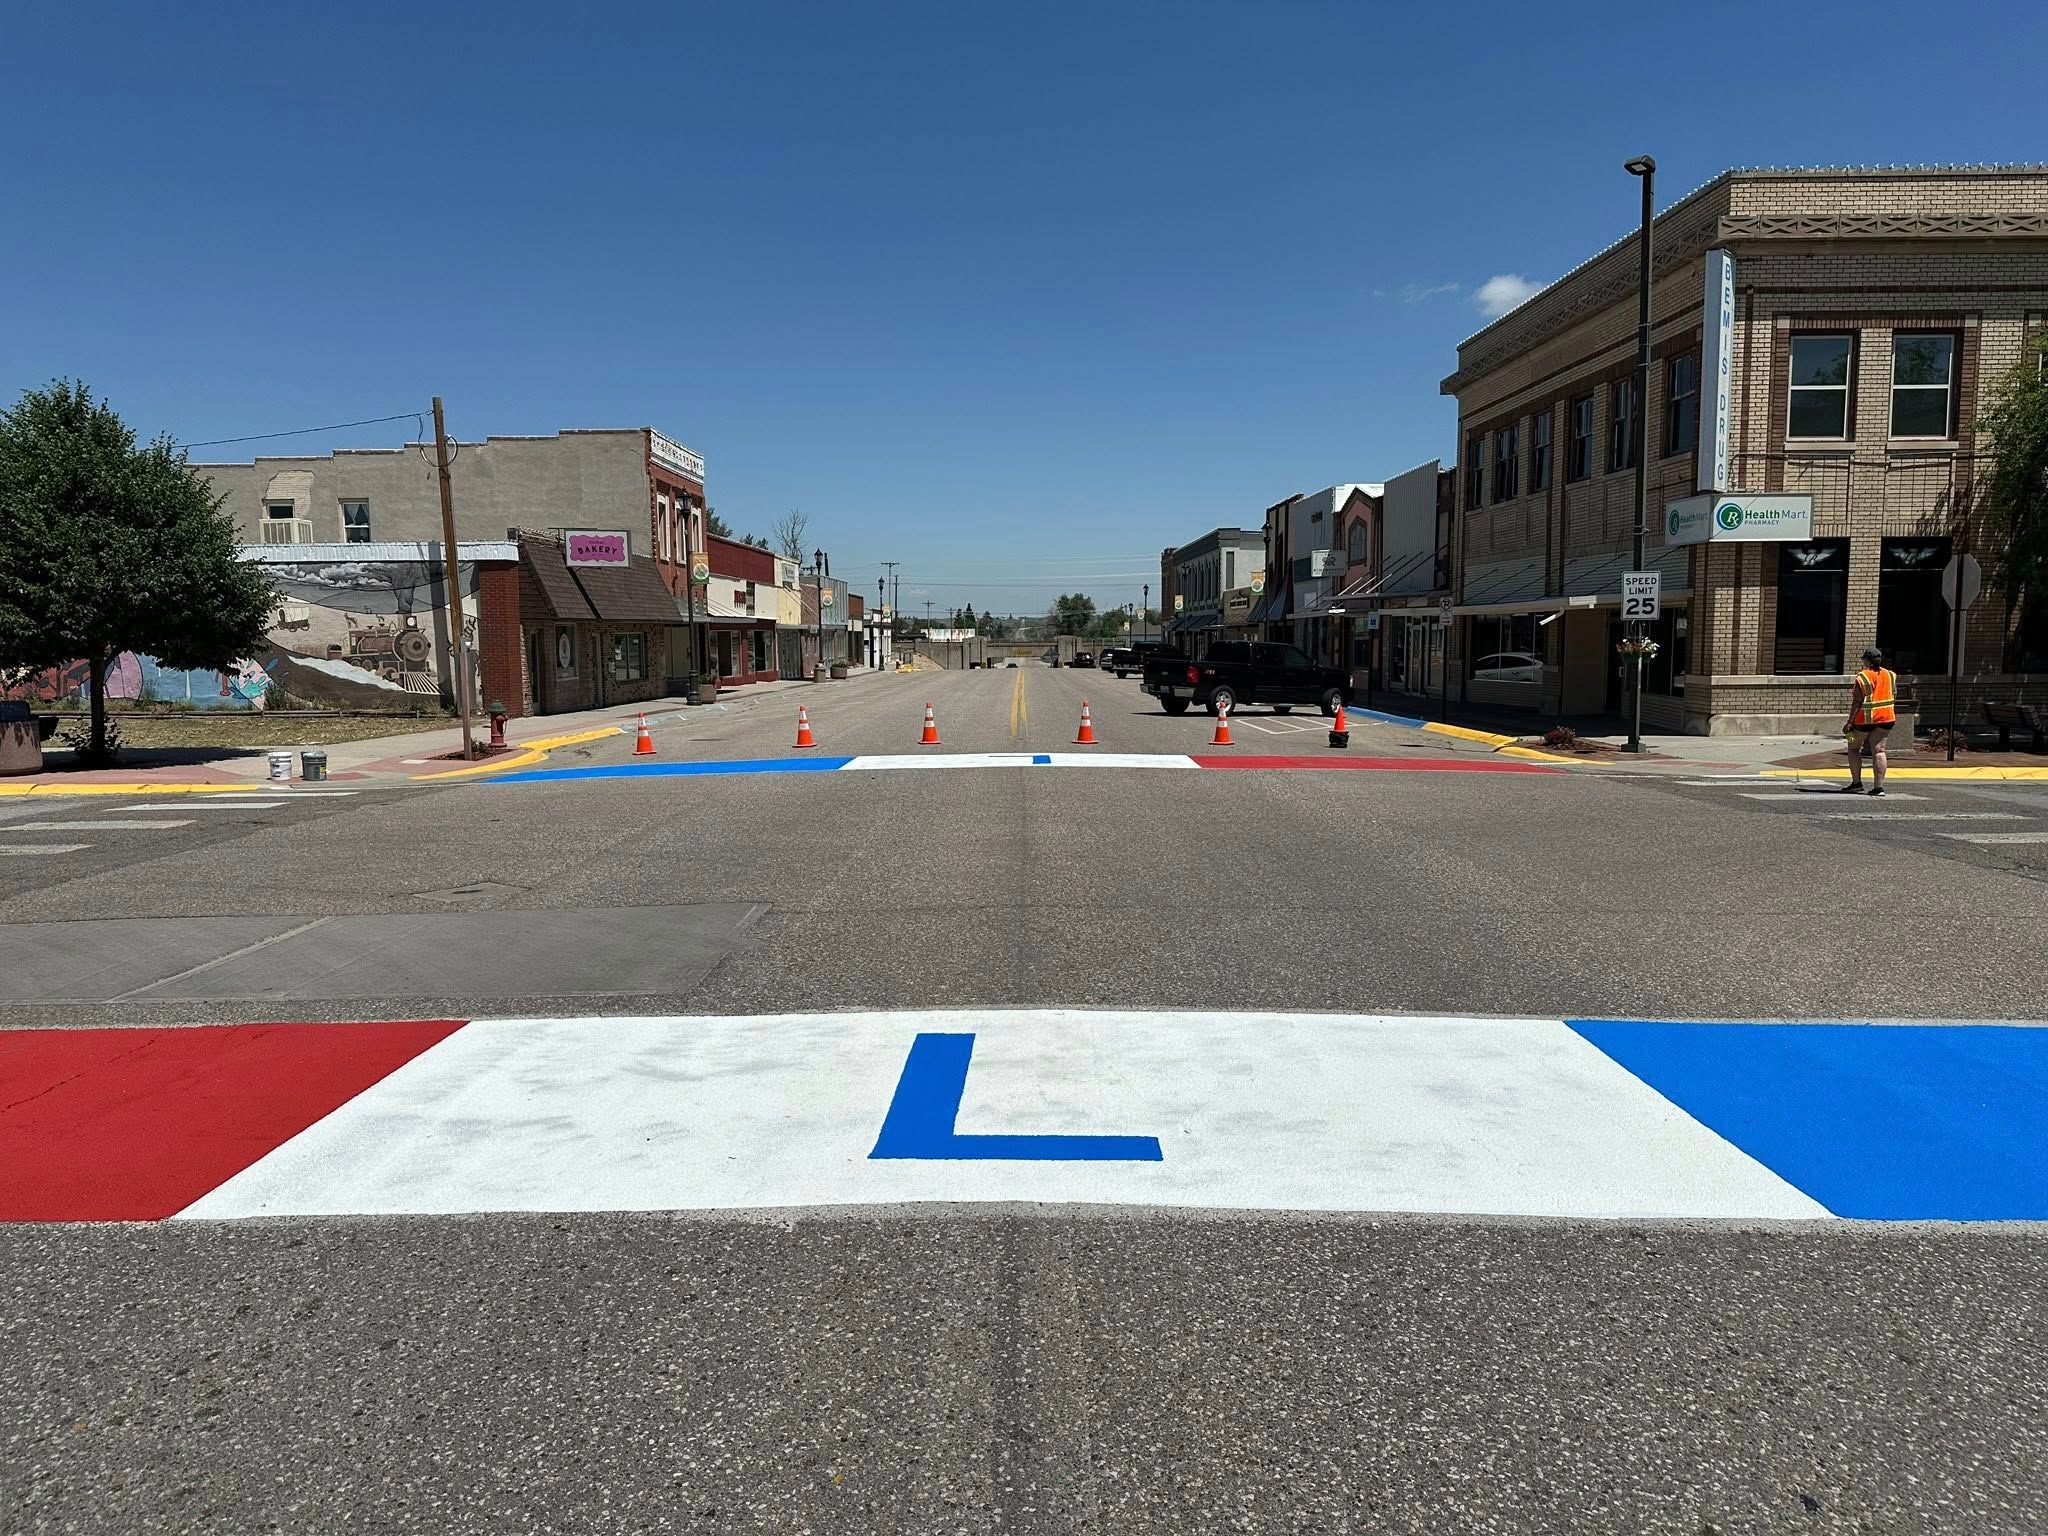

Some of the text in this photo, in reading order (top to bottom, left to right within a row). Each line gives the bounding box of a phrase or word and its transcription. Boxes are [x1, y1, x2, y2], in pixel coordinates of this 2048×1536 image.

[1717, 263, 1731, 481] BEMIS DRUG
[1745, 510, 1780, 519] Health
[577, 545, 618, 555] BAKERY
[1625, 577, 1657, 586] SPEED
[1629, 587, 1653, 595] LIMIT
[1626, 597, 1655, 616] 25
[867, 1033, 1164, 1161] L
